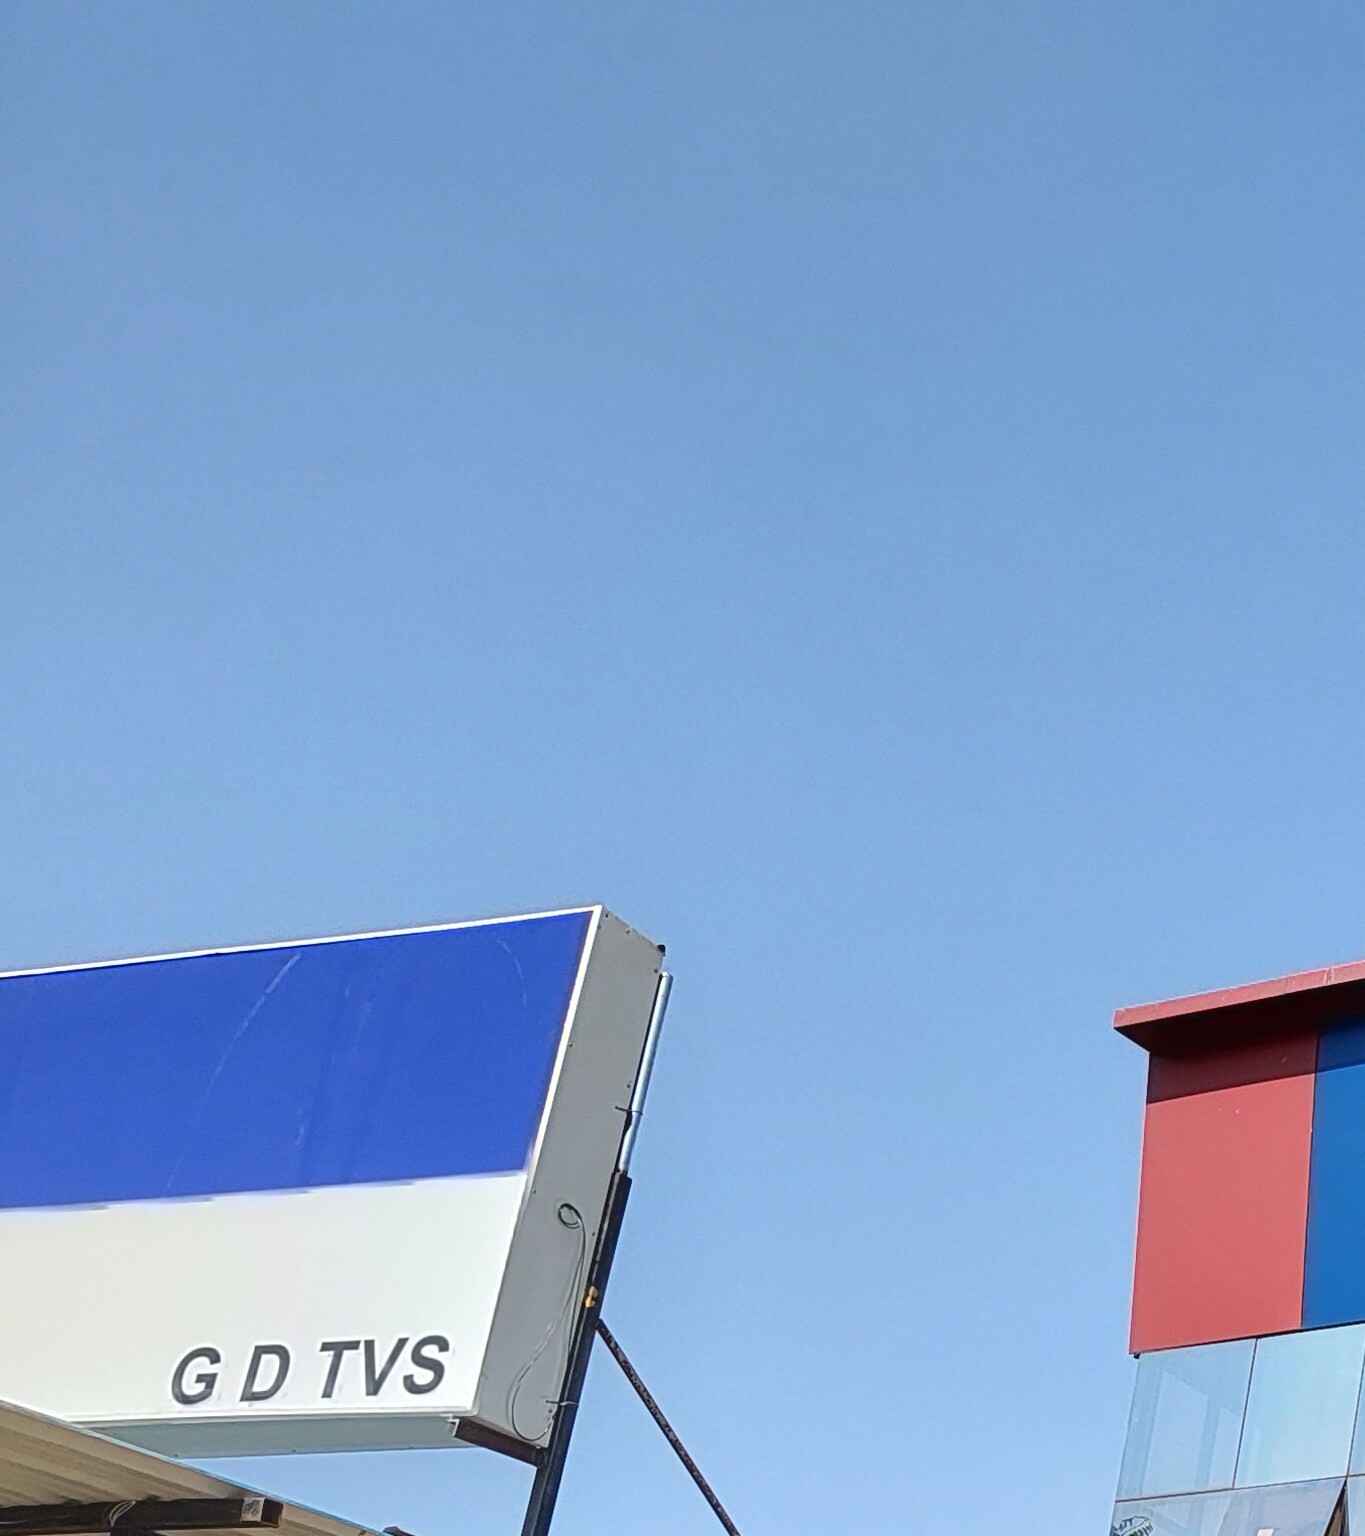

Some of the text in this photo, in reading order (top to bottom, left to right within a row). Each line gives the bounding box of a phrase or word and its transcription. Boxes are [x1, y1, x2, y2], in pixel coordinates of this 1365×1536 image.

[171, 1334, 450, 1406] G D TVS
